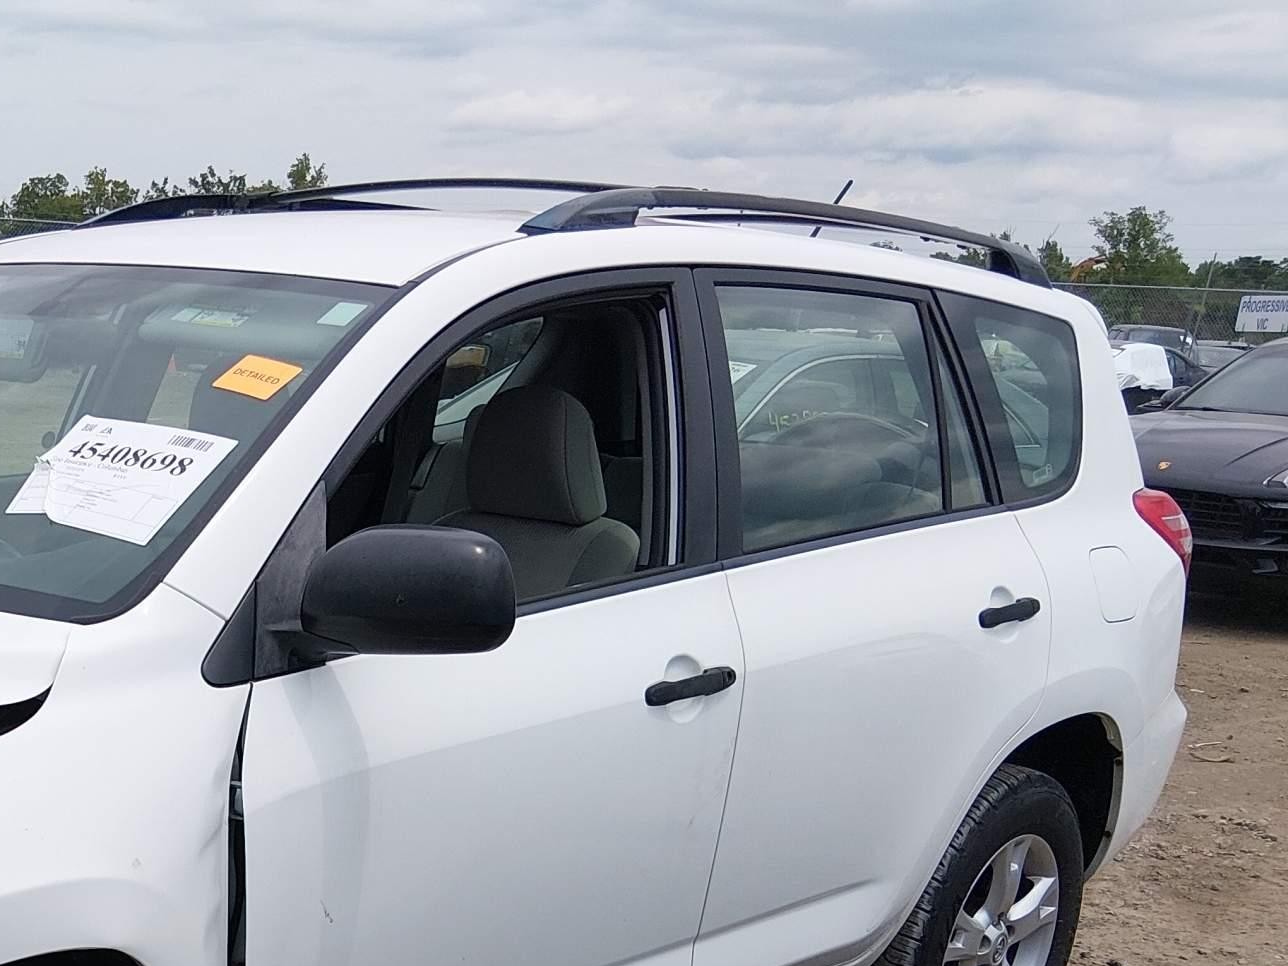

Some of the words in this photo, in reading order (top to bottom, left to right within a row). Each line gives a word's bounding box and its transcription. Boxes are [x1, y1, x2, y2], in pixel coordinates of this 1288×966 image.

[1256, 318, 1269, 330] VIC
[232, 367, 281, 385] DETAILED
[68, 440, 194, 477] 45408698
